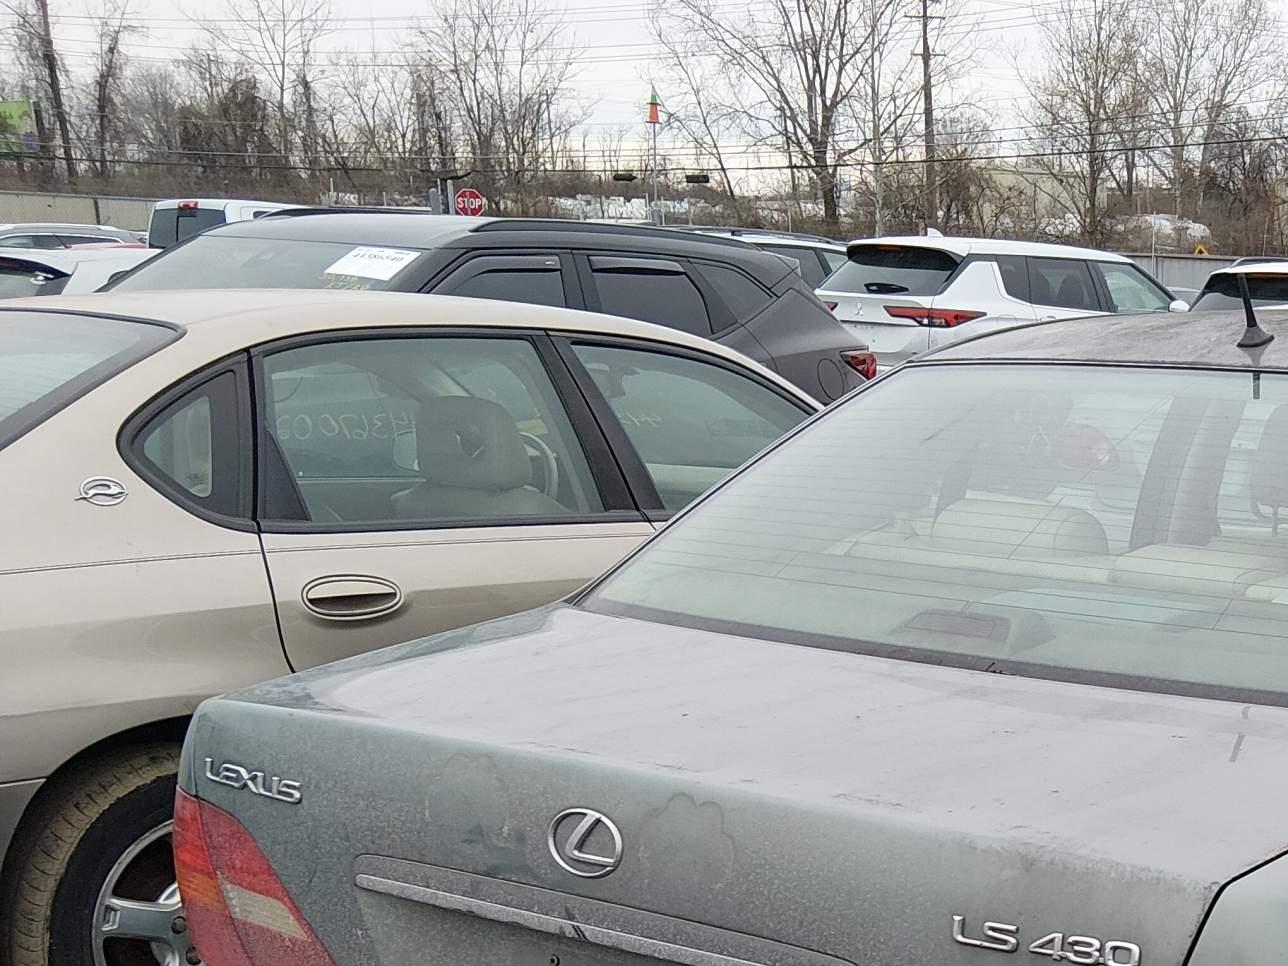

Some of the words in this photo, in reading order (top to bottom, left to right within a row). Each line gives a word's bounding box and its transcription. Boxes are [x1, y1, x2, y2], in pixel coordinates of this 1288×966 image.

[458, 196, 482, 209] STOP
[204, 757, 303, 804] LEXUS
[952, 914, 1019, 952] LS
